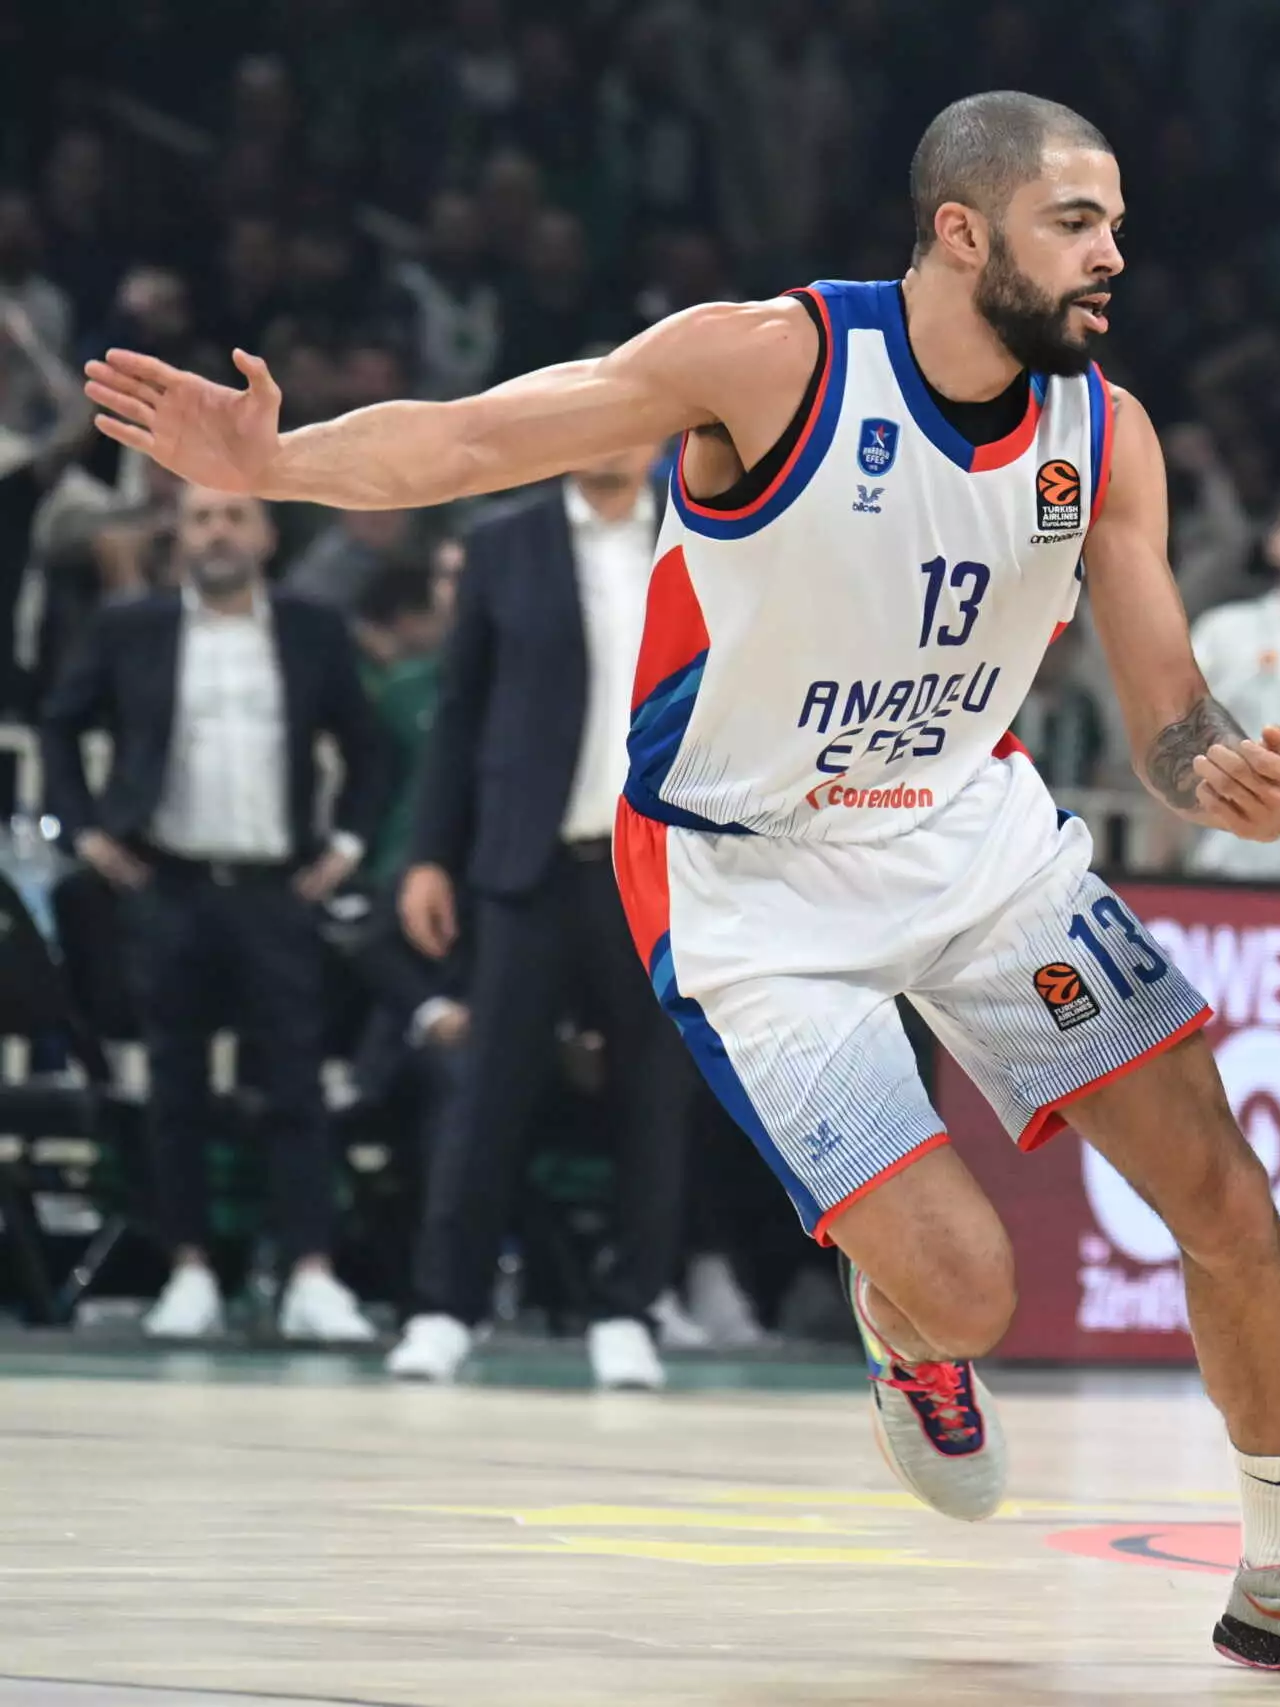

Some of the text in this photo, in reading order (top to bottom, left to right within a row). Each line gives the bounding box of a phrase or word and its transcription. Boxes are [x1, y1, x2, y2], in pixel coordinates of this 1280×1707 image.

[865, 454, 885, 465] EFES
[1042, 505, 1078, 514] TURKISH
[1043, 512, 1078, 521] AIRLINES
[1030, 531, 1083, 544] oneteam
[918, 555, 991, 648] 13
[816, 719, 946, 774] EFES
[827, 781, 934, 809] corendon
[1067, 895, 1168, 1001] 13
